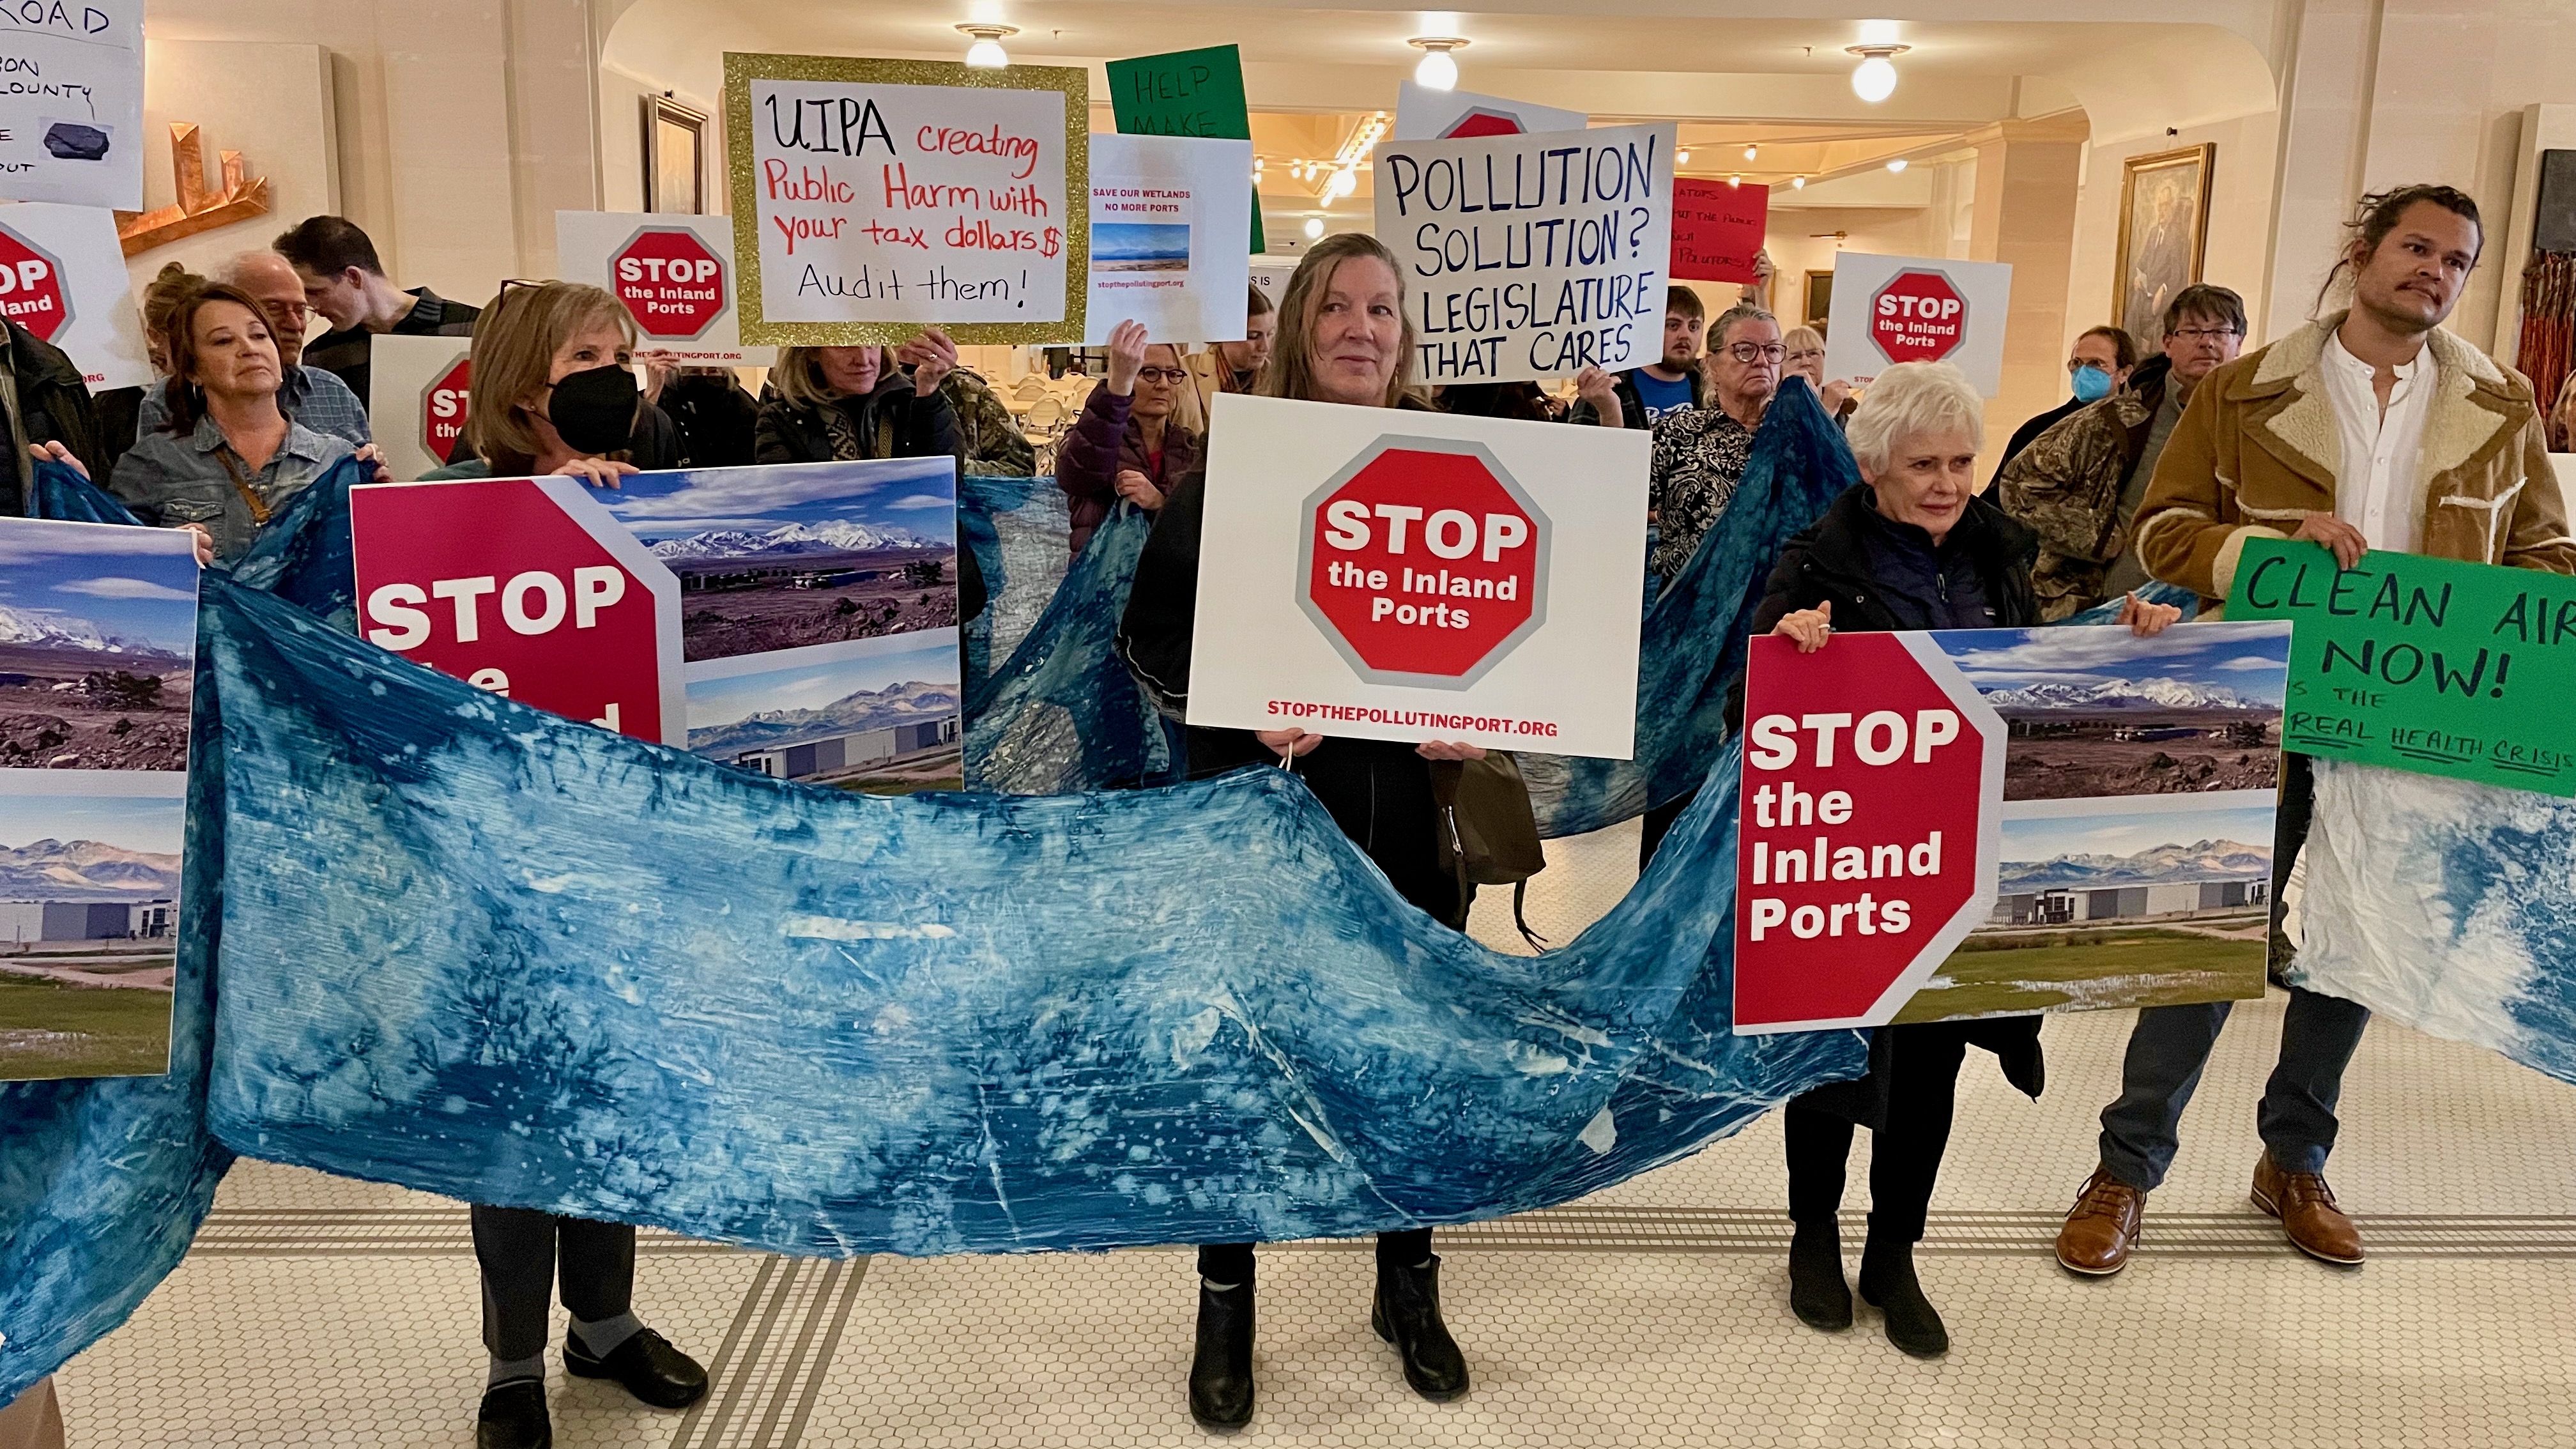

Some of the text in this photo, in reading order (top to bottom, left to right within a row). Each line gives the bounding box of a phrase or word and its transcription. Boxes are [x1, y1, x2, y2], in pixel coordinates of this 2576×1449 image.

[0, 0, 109, 34] OAD
[0, 57, 39, 77] ON
[1135, 66, 1210, 104] HELP
[0, 82, 95, 110] OUNTY
[765, 94, 1039, 179] UIPA creating
[1133, 111, 1217, 137] MAKE
[764, 158, 1048, 217] Public Harm with
[1093, 188, 1190, 199] SAVE OUR WETLANDS
[1387, 134, 1656, 216] POLLUTION
[1105, 203, 1179, 213] NO MORE PORTS
[1675, 188, 1718, 200] ATORS
[773, 213, 847, 255] your
[861, 218, 930, 250] tax
[1696, 211, 1717, 222] THE
[1415, 207, 1650, 277] SOLUTION?
[620, 257, 717, 283] STOP
[797, 263, 905, 300] Audit
[1261, 276, 1270, 286] IS
[624, 285, 716, 301] the Inland
[647, 301, 694, 315] Ports
[1423, 272, 1654, 334] LEGISLATURE
[1878, 295, 1961, 319] STOP
[1879, 319, 1956, 336] the Inland
[1896, 334, 1936, 348] Ports
[1417, 324, 1632, 379] THAT CARES
[1325, 500, 1528, 562] STOP
[1328, 561, 1517, 601] the Inland
[367, 565, 626, 651] STOP
[1372, 597, 1470, 629] Ports
[2246, 556, 2576, 645] CLEAN AIR
[2322, 640, 2511, 698] NOW!
[2287, 681, 2389, 709] S THE
[1268, 700, 1558, 737] STOPTHEPOLLUTINGPORT.ORG
[1749, 709, 1960, 770] STOP
[2290, 712, 2374, 740] REAL
[2494, 740, 2573, 767] CRISIS
[1753, 782, 1853, 829] the
[1753, 831, 1942, 885] Inland
[1751, 893, 1912, 941] Ports
